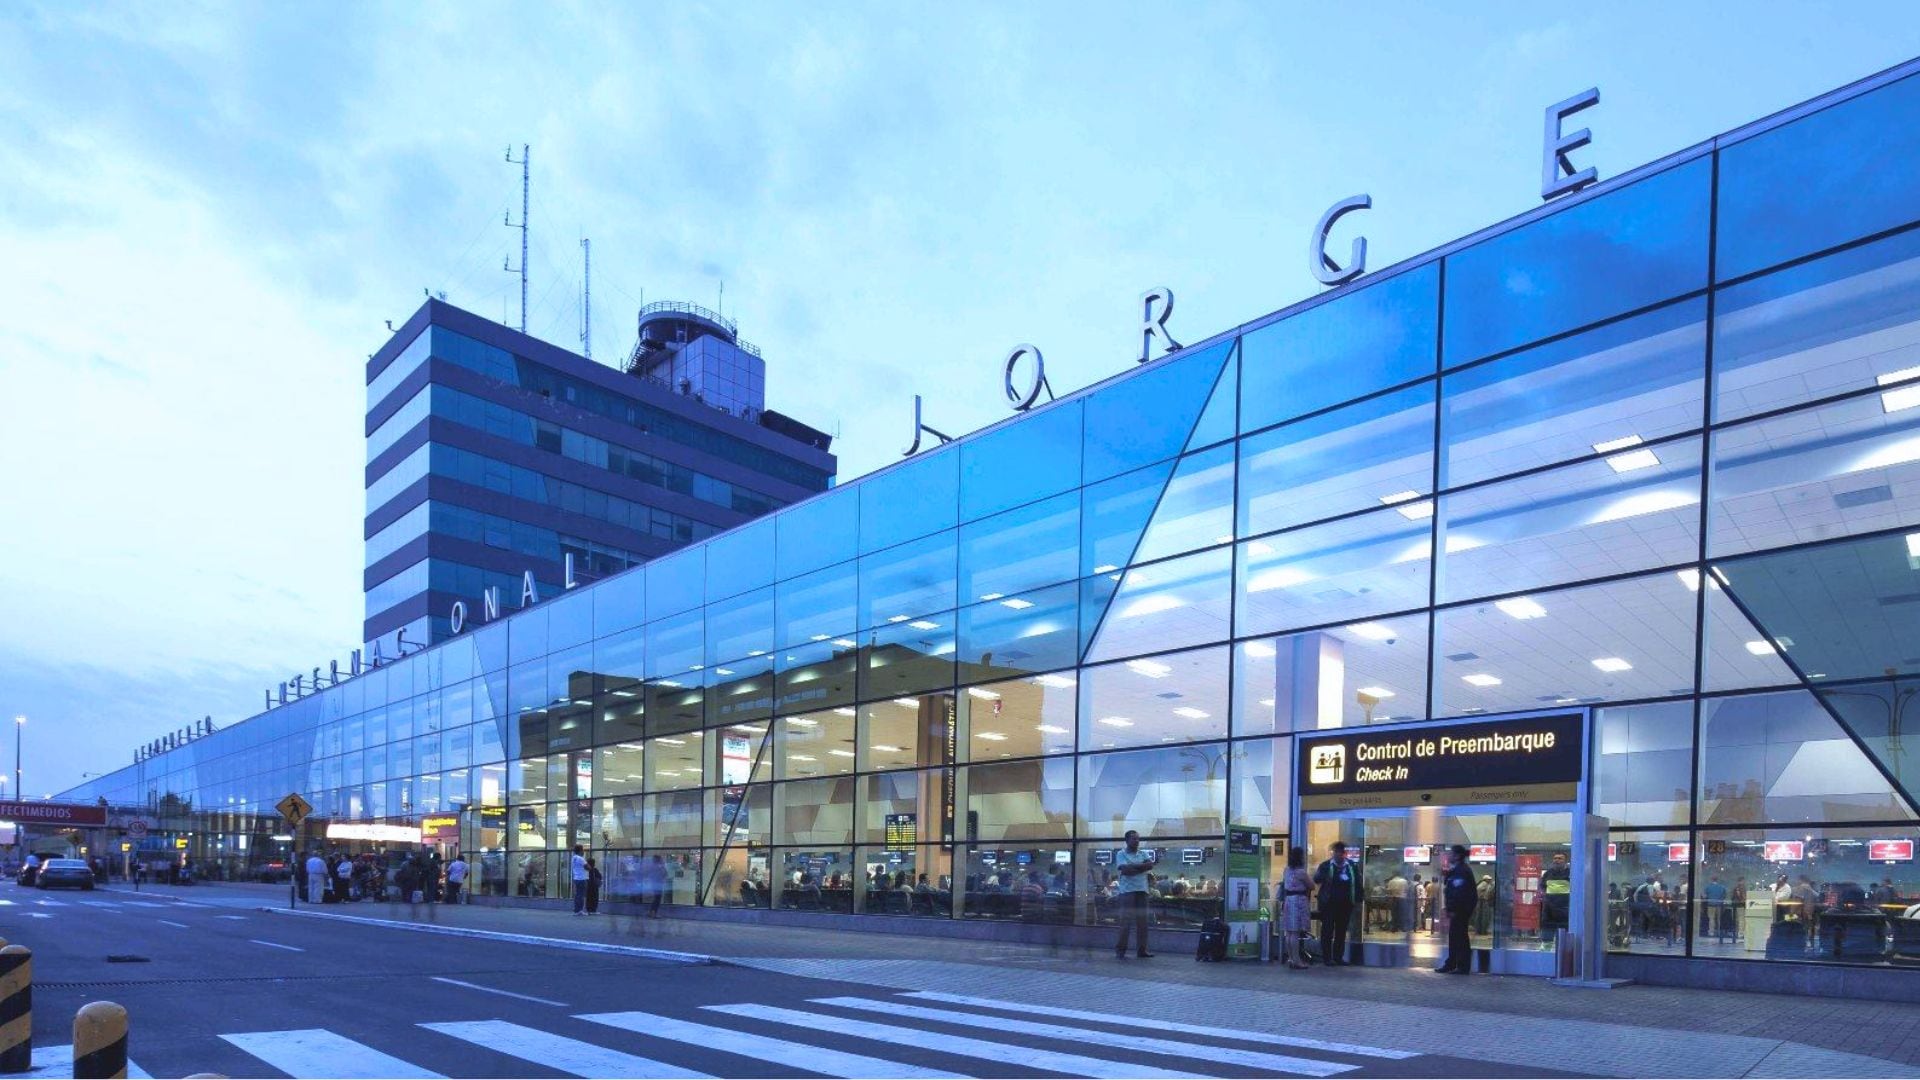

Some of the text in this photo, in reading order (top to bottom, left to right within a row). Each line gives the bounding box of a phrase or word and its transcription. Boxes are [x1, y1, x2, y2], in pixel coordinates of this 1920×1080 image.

[902, 86, 1600, 456] JORGE
[1357, 732, 1554, 761] Control de Preembarque
[1356, 766, 1409, 782] Check In
[1620, 843, 1634, 854] 27
